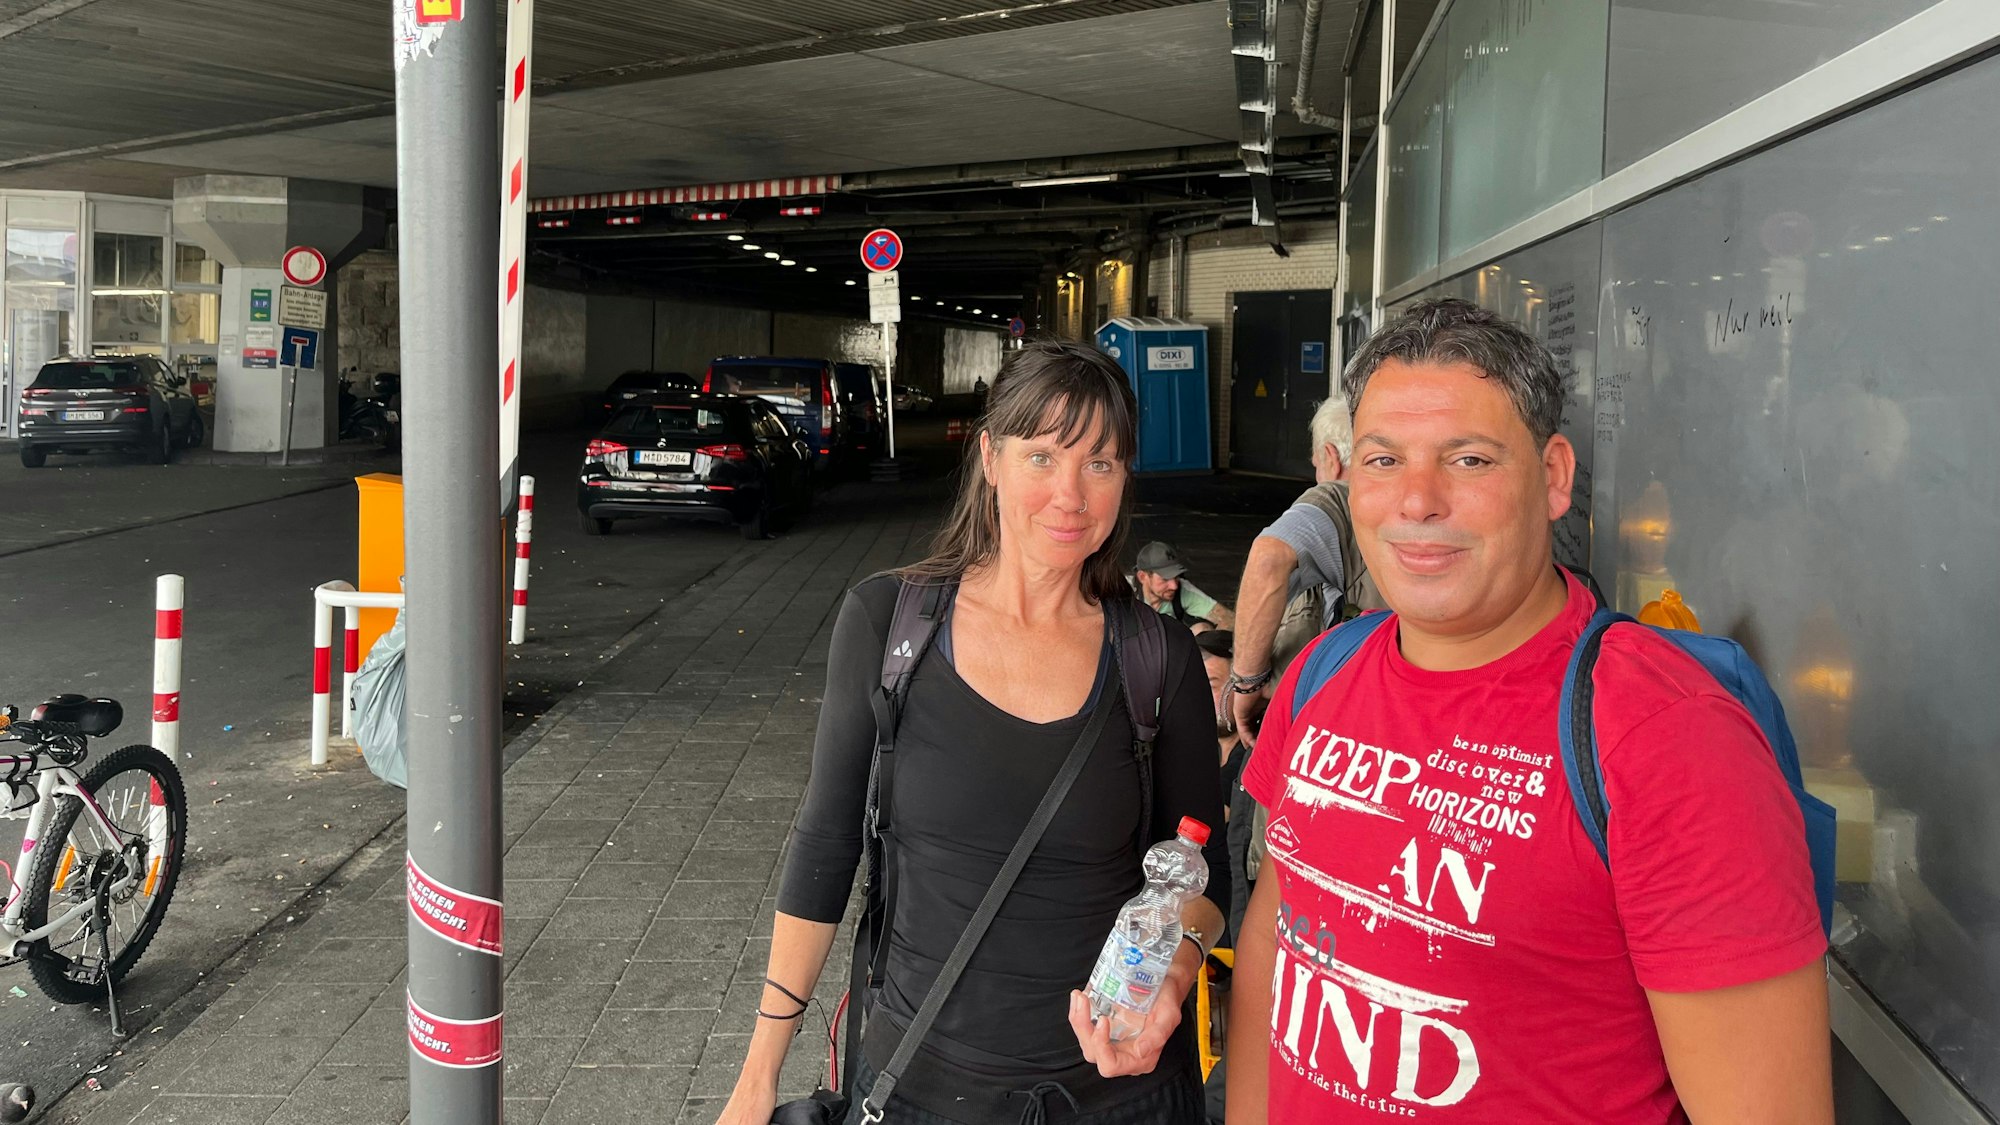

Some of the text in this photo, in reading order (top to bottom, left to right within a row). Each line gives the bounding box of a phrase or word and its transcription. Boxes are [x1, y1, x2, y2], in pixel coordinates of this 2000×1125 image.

[284, 288, 324, 302] Bahn-Anlage
[1715, 298, 1748, 347] Nur
[1160, 351, 1182, 360] DIXI
[1290, 724, 1421, 804] KEEP
[1427, 748, 1525, 788] discover
[1453, 734, 1469, 750] be
[1492, 743, 1554, 769] optimist
[1408, 782, 1537, 839] HORIZONS
[1481, 785, 1523, 804] new
[416, 880, 456, 911] ECKEN
[1379, 836, 1496, 925] AN
[1276, 900, 1336, 971] pen
[409, 1005, 435, 1035] CKEN
[1293, 1057, 1305, 1076] to
[1308, 1068, 1330, 1091] ride
[1333, 1080, 1357, 1103] the
[1360, 1094, 1416, 1118] future
